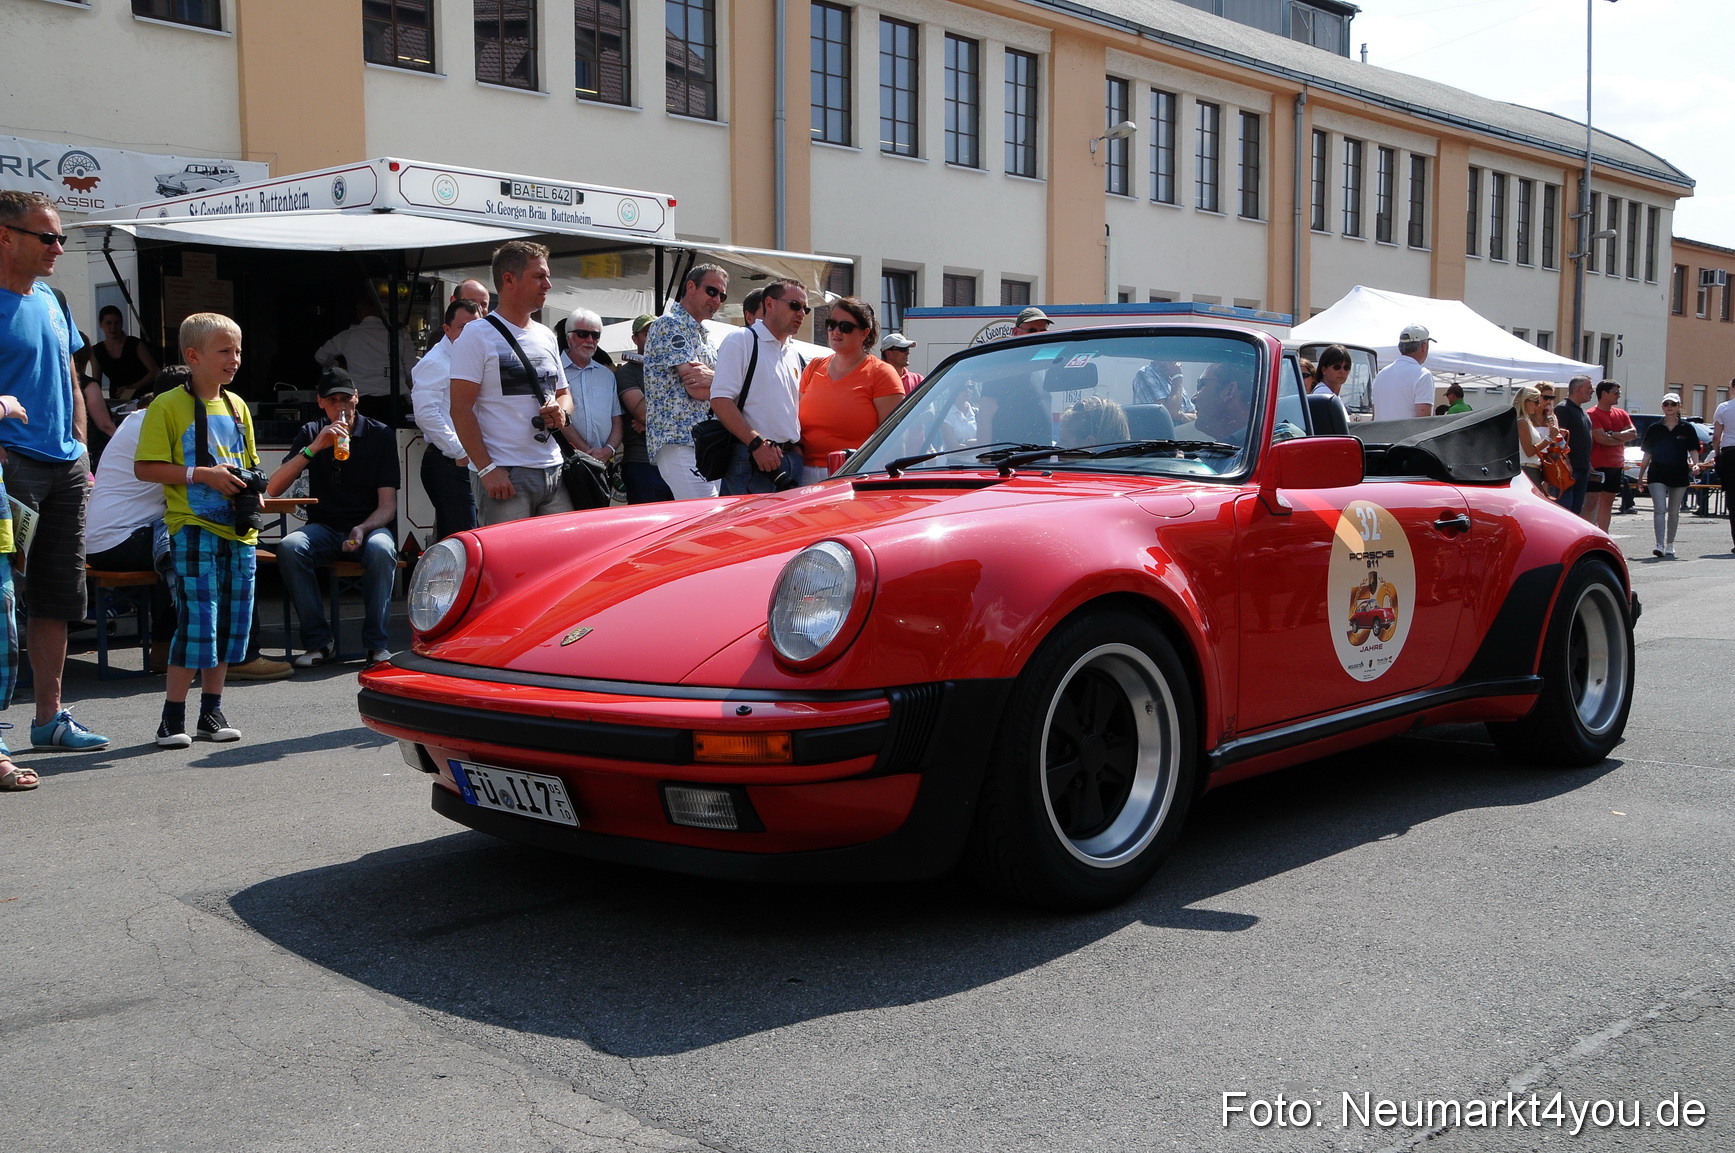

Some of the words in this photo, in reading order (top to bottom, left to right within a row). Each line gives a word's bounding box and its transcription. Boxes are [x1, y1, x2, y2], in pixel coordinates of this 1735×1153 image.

[32, 191, 105, 209] ASSIC
[259, 187, 310, 213] Buttenheim
[514, 183, 530, 196] BA
[536, 186, 549, 199] EL
[551, 188, 570, 202] 642
[486, 200, 496, 214] St.
[497, 201, 527, 220] Georgen
[528, 205, 547, 220] Bräu
[551, 208, 592, 225] Buttenheim
[1616, 334, 1624, 358] 5
[1065, 390, 1082, 404] 1624
[1355, 506, 1382, 542] 32
[1349, 550, 1395, 561] PORSCHE
[1366, 560, 1379, 569] 911
[1359, 643, 1383, 653] JAHRE
[463, 768, 501, 806] FÜ
